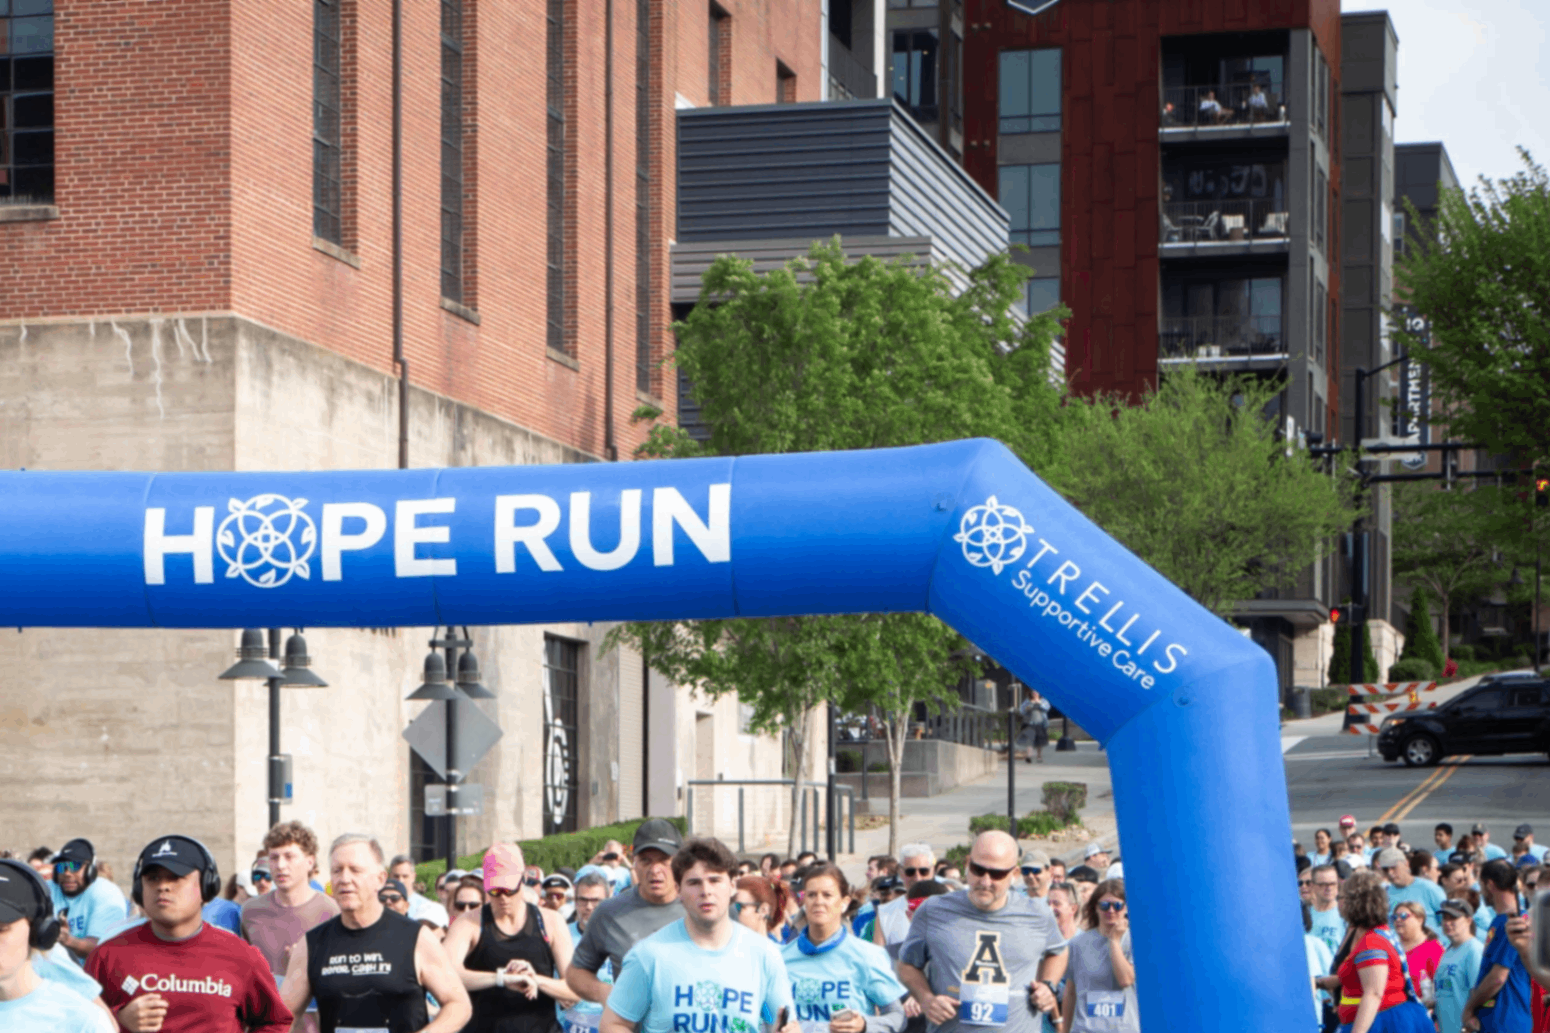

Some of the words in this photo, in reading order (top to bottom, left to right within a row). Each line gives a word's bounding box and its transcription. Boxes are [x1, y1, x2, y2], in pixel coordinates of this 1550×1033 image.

[144, 493, 457, 588] HOPE
[495, 483, 731, 575] RUN
[1027, 538, 1187, 674] TRELLIS
[1011, 569, 1112, 658] Supportive
[1112, 649, 1155, 690] Care
[961, 930, 1010, 984] A
[140, 973, 232, 998] Columbia
[674, 980, 754, 1014] HOPE
[796, 1003, 831, 1021] UN
[971, 1002, 994, 1022] 92
[1093, 1003, 1116, 1017] 401
